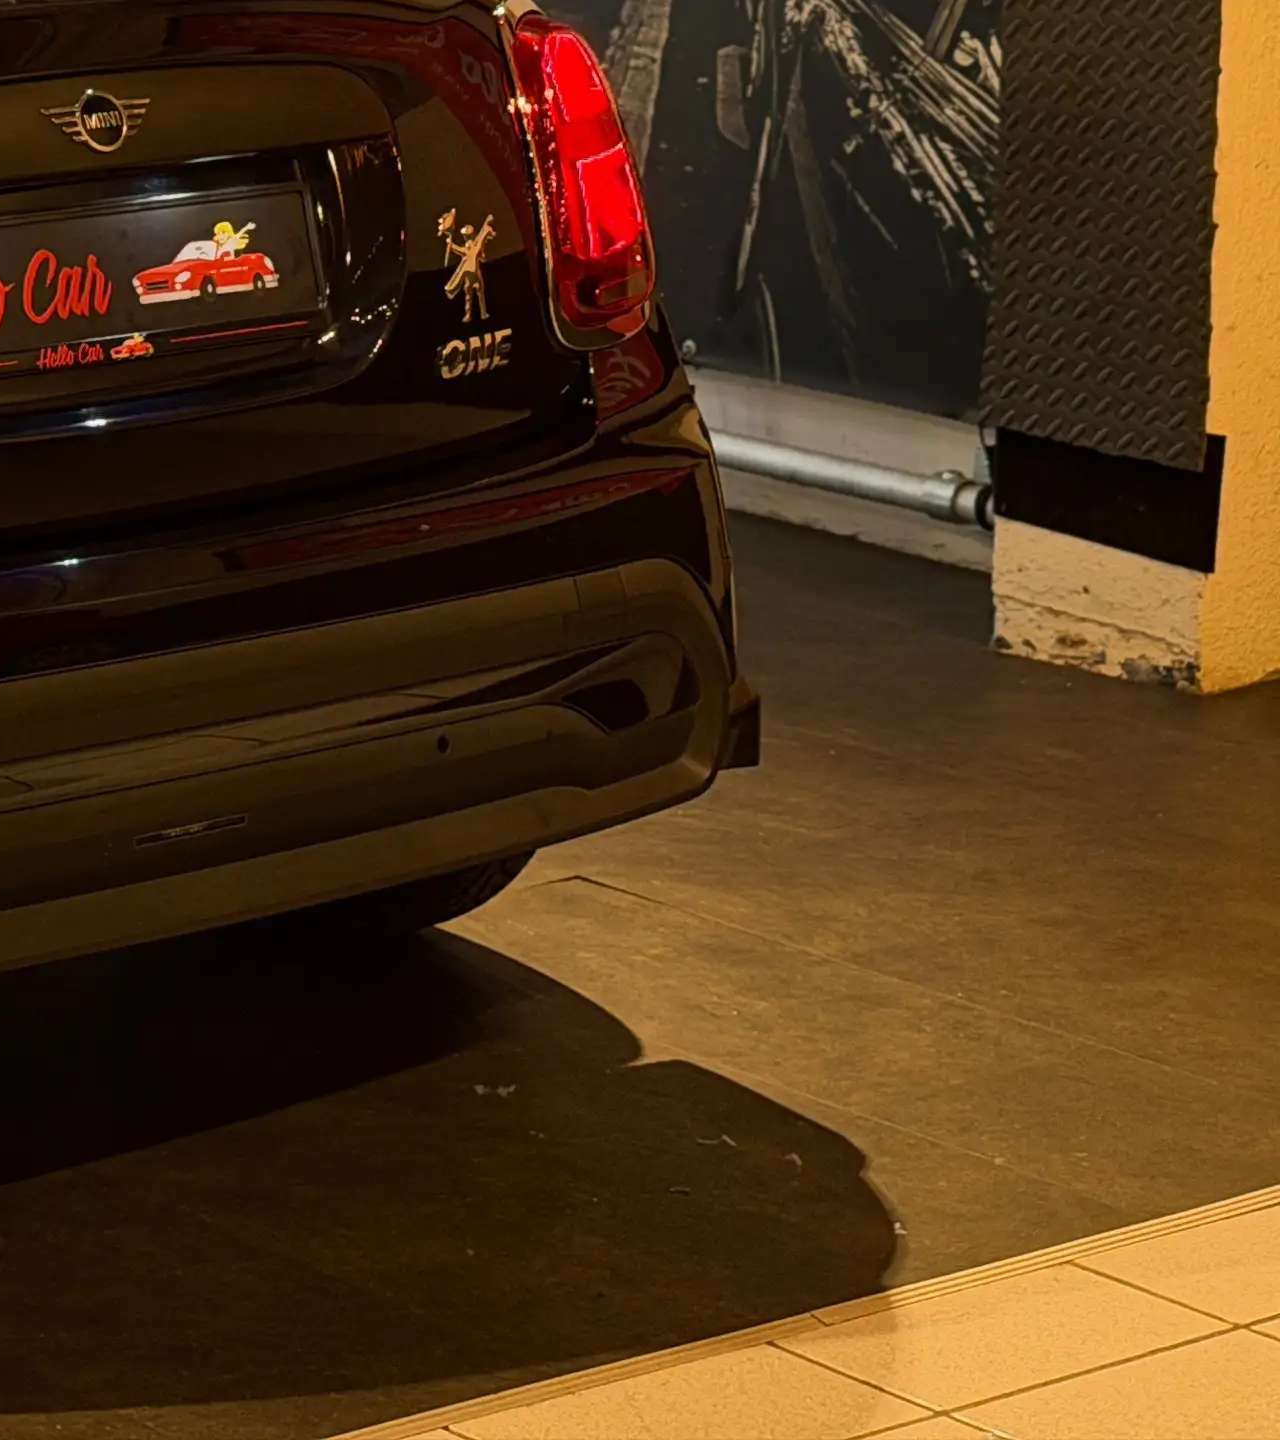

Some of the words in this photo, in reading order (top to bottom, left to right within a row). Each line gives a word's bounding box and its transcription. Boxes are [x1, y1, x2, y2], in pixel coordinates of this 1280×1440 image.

[83, 110, 122, 130] MINI
[22, 249, 113, 325] Car
[36, 345, 76, 370] Hello
[77, 343, 104, 367] Car
[437, 328, 512, 379] ONE
